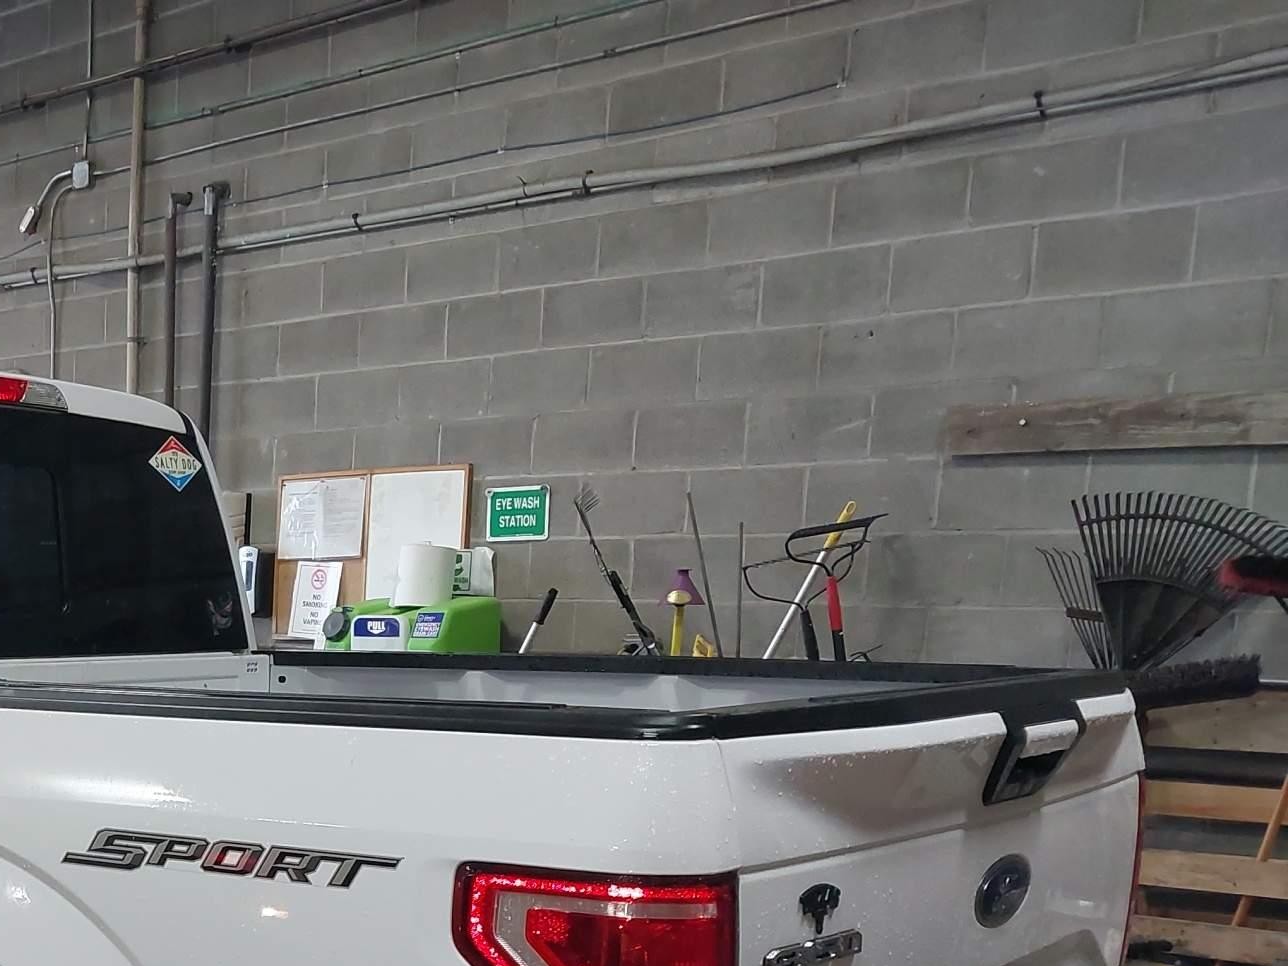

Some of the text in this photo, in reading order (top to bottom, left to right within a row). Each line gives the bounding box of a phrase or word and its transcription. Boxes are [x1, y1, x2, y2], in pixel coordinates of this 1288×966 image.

[154, 456, 197, 470] SALTY DOG
[495, 495, 540, 511] EYE WASH
[498, 514, 537, 528] STATION
[367, 620, 385, 630] PULL
[61, 827, 405, 889] SPORT
